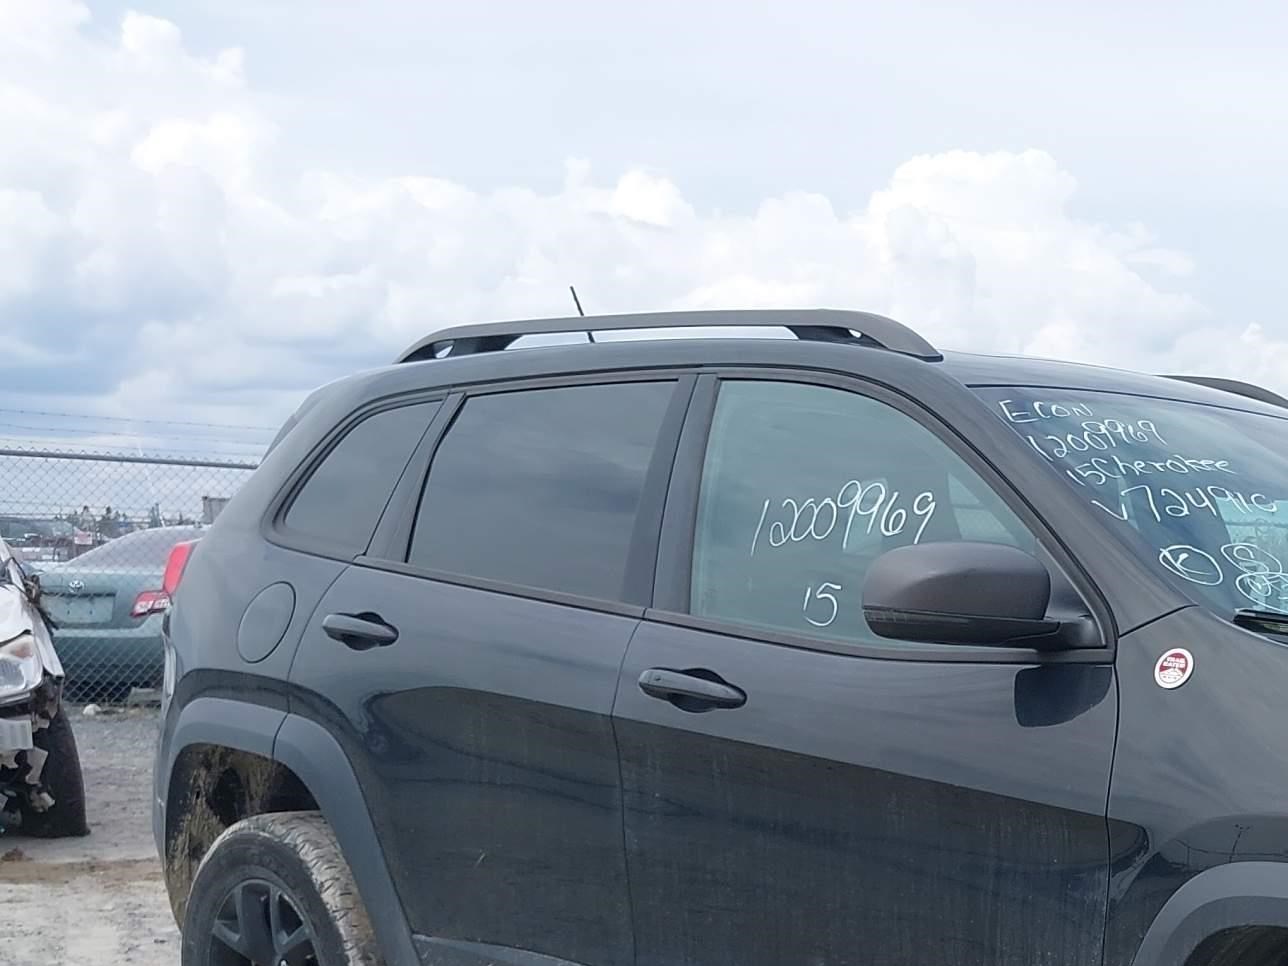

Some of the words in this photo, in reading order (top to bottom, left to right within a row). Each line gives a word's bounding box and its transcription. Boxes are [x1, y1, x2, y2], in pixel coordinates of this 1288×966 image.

[1027, 418, 1169, 462] 12009969
[751, 479, 937, 557] 12009969
[802, 581, 843, 627] 15
